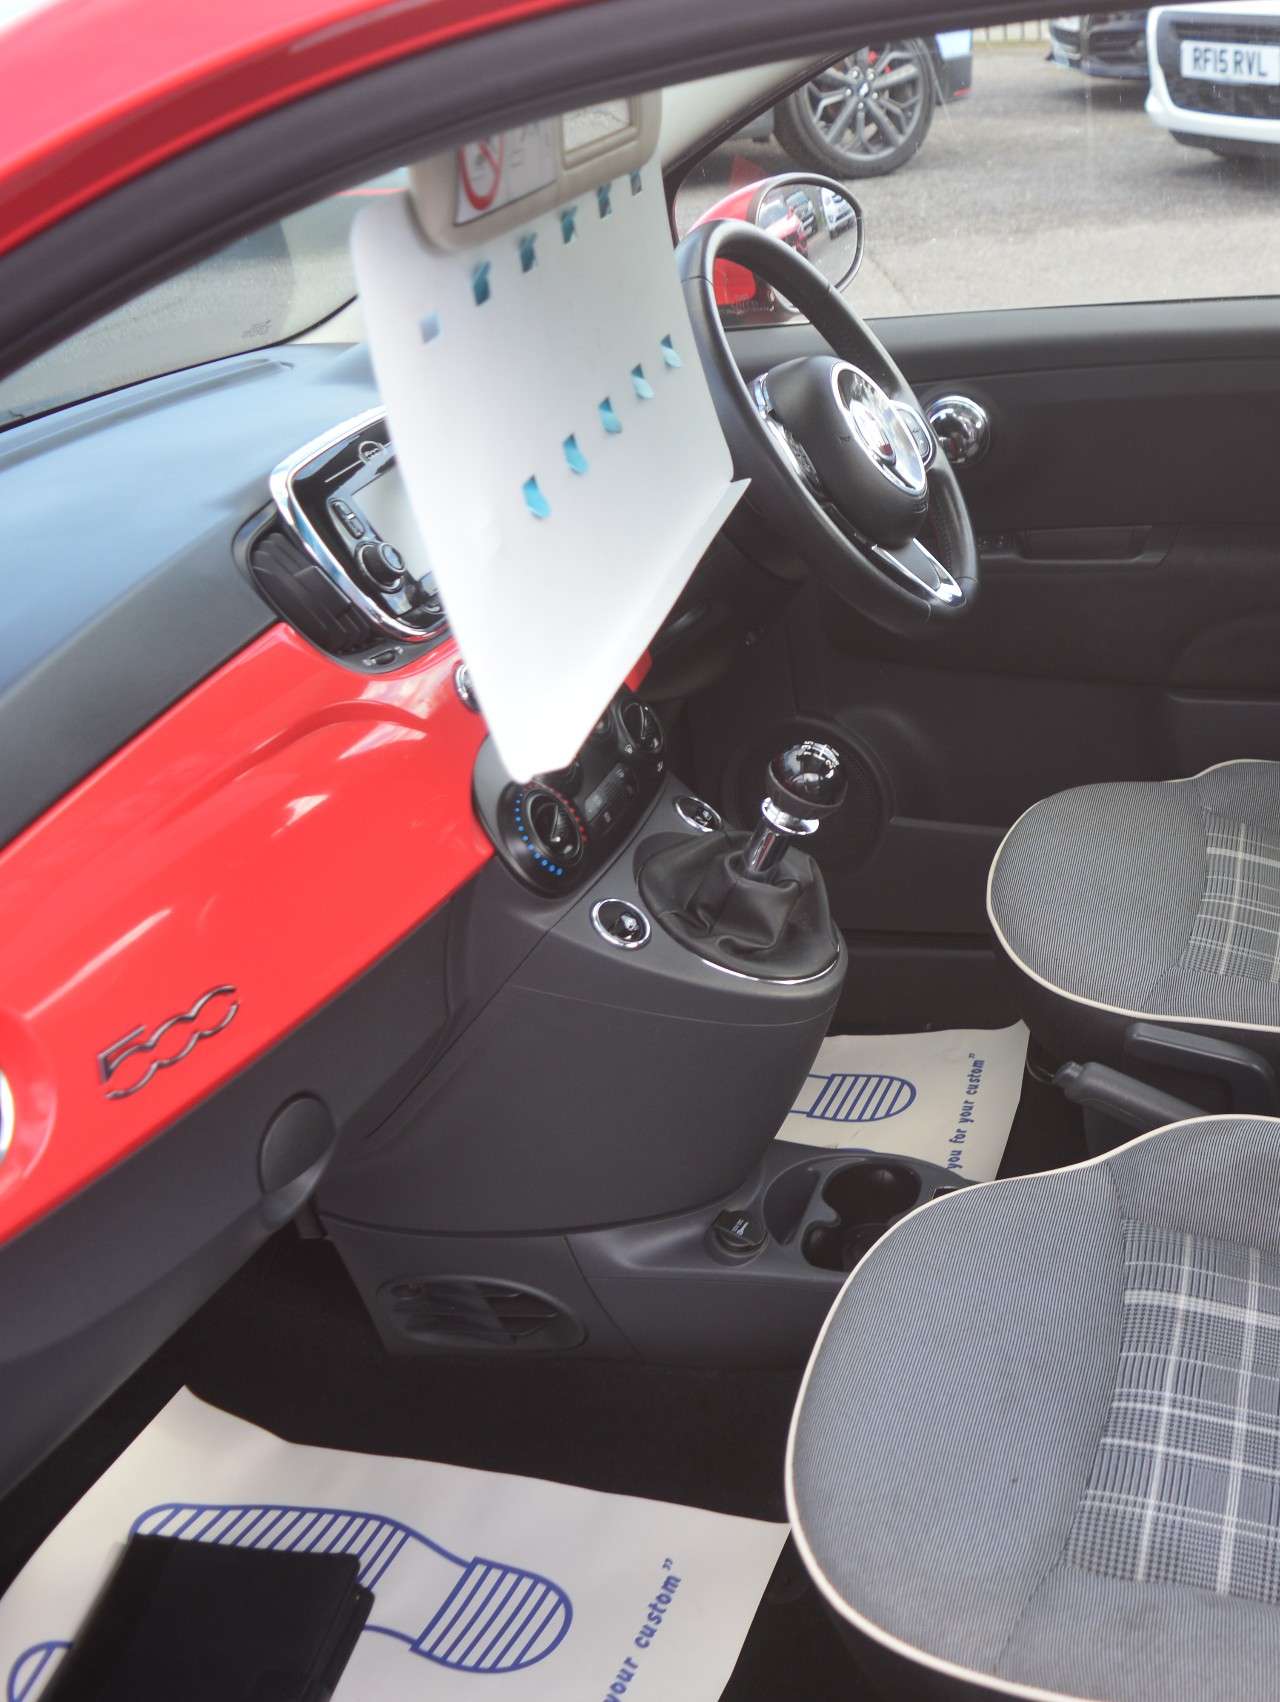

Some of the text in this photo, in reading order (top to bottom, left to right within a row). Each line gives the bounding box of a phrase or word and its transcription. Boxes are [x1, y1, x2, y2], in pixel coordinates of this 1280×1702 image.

[1193, 47, 1268, 77] RF15 RVL
[97, 984, 239, 1100] 500
[958, 1099, 975, 1124] your
[948, 1128, 967, 1144] for
[947, 1149, 963, 1169] you
